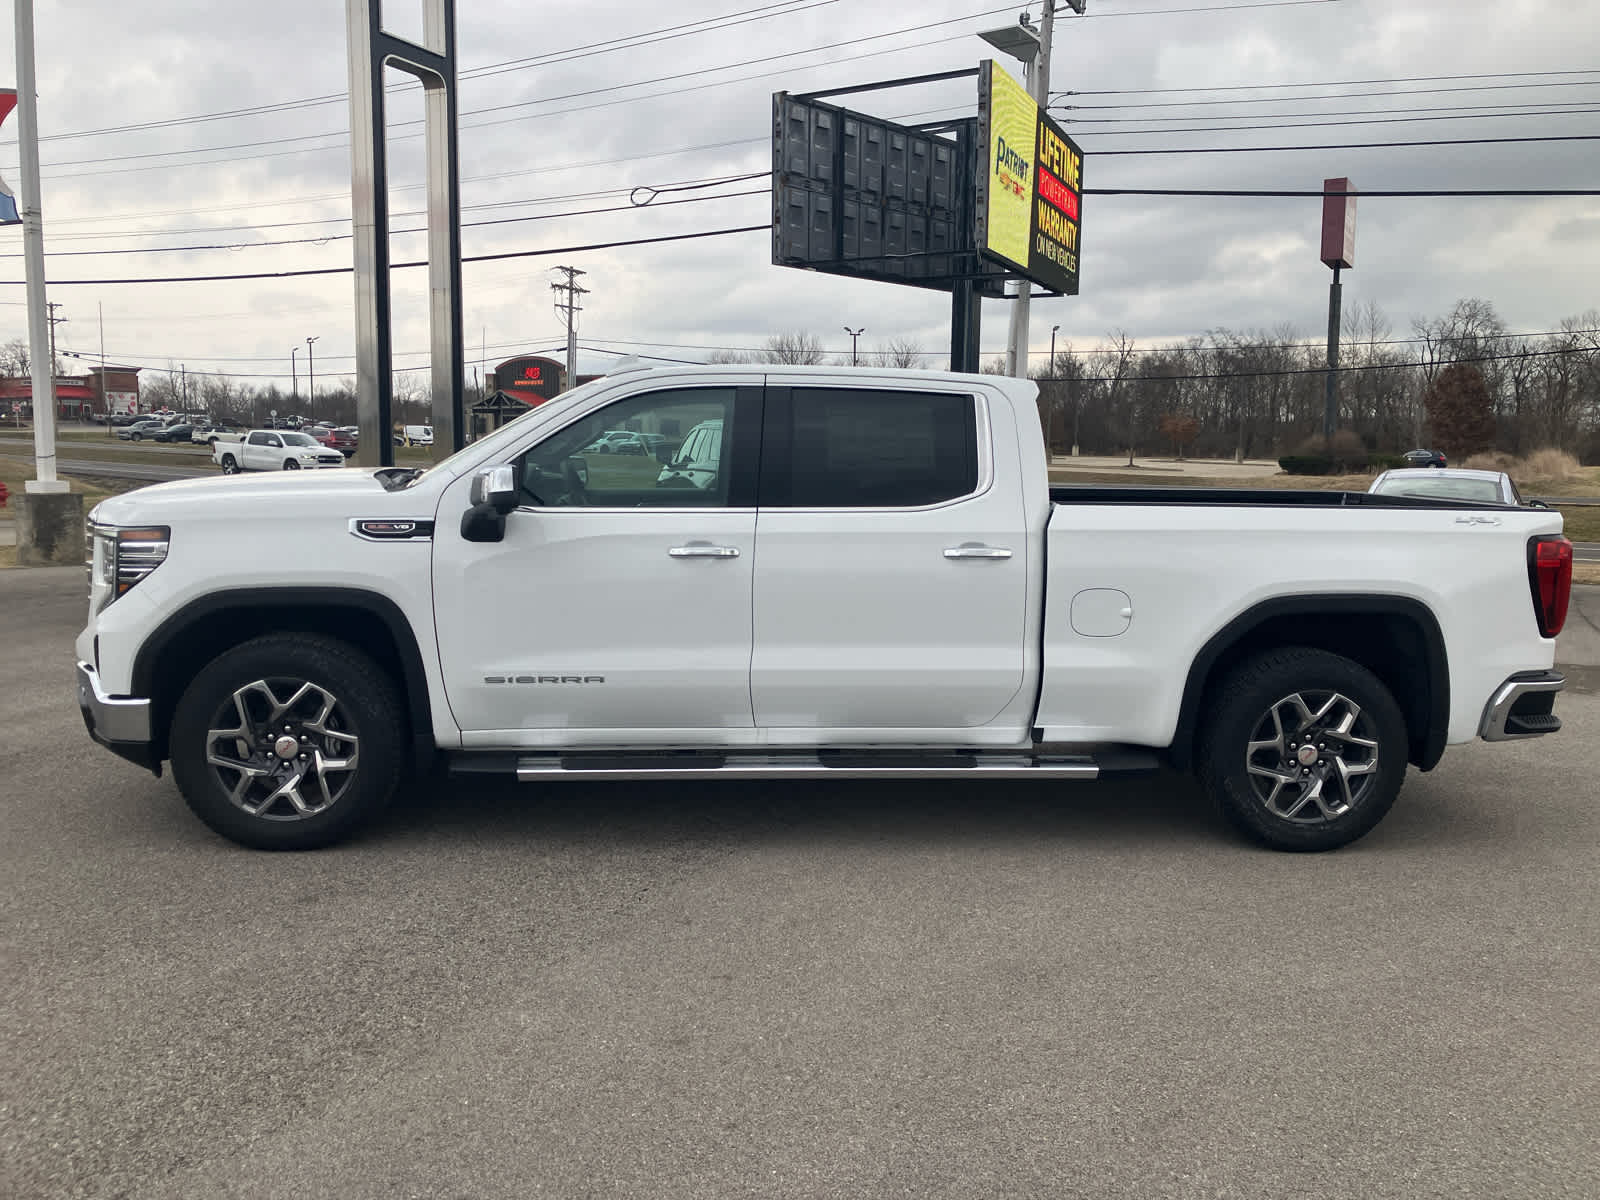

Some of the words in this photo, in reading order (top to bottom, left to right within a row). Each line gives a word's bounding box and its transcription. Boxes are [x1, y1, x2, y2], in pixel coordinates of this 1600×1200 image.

[996, 135, 1028, 184] PATRIOT
[1040, 121, 1079, 193] LIFETIME
[1040, 172, 1077, 217] POWERTRAIN
[1036, 233, 1045, 256] ON
[1037, 198, 1077, 252] WARRANTY
